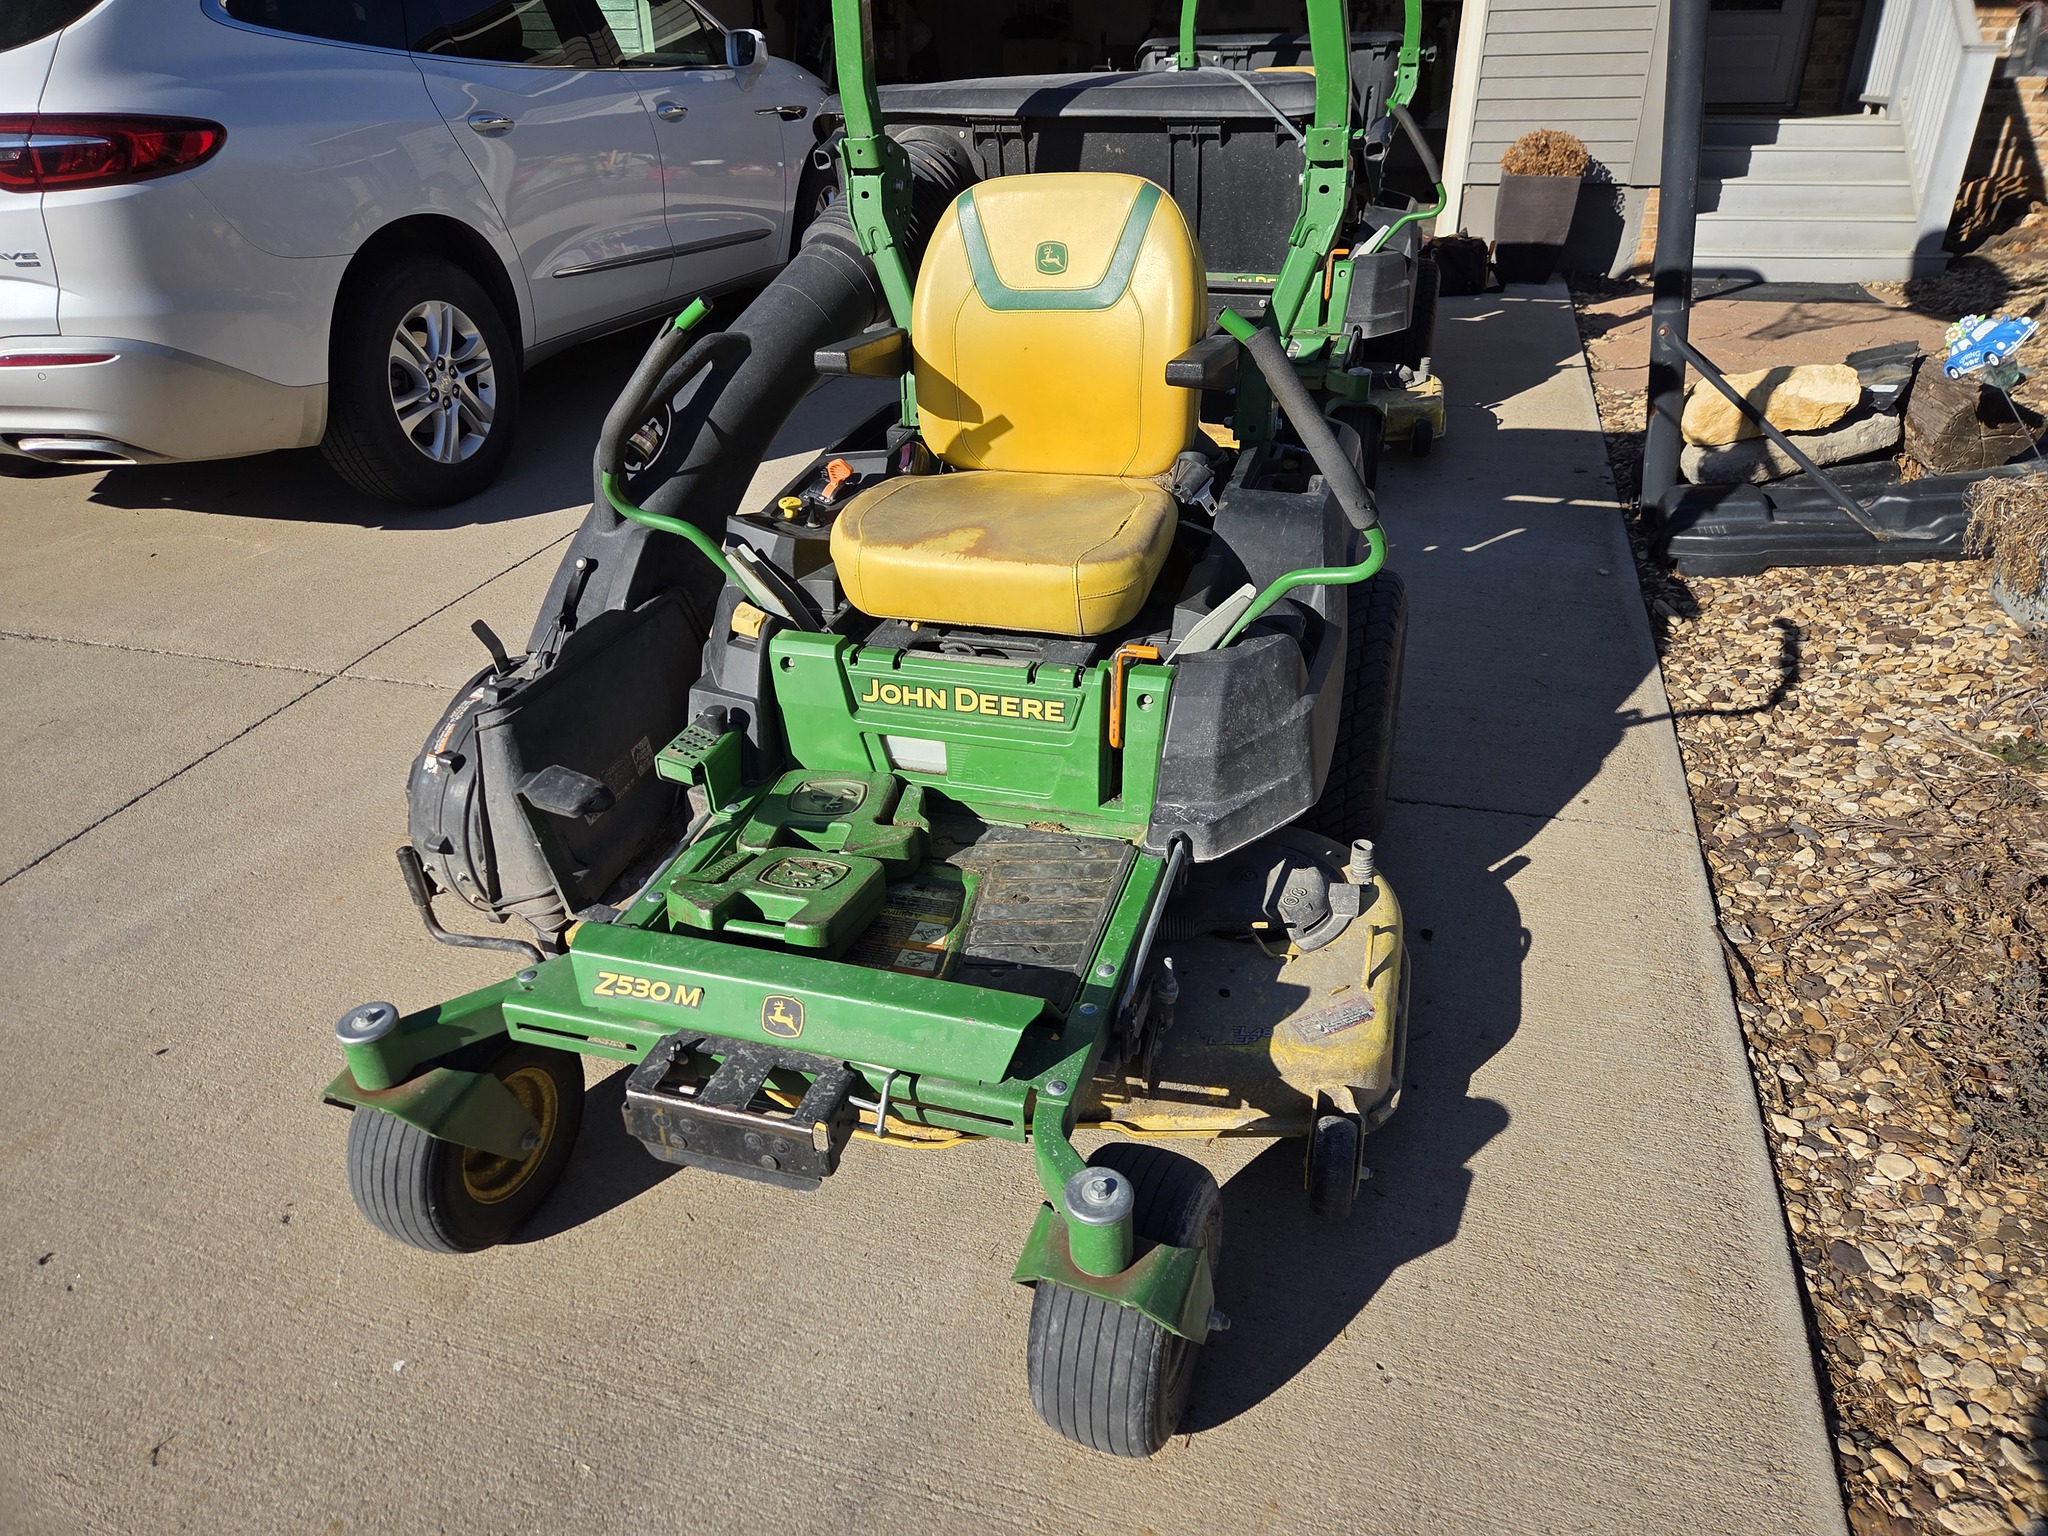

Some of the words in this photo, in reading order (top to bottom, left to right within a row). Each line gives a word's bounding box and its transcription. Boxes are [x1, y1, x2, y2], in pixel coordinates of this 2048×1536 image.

[862, 678, 948, 711] JOHN
[954, 686, 1066, 723] DEERE
[593, 971, 672, 1001] Z530
[673, 984, 703, 1007] M
